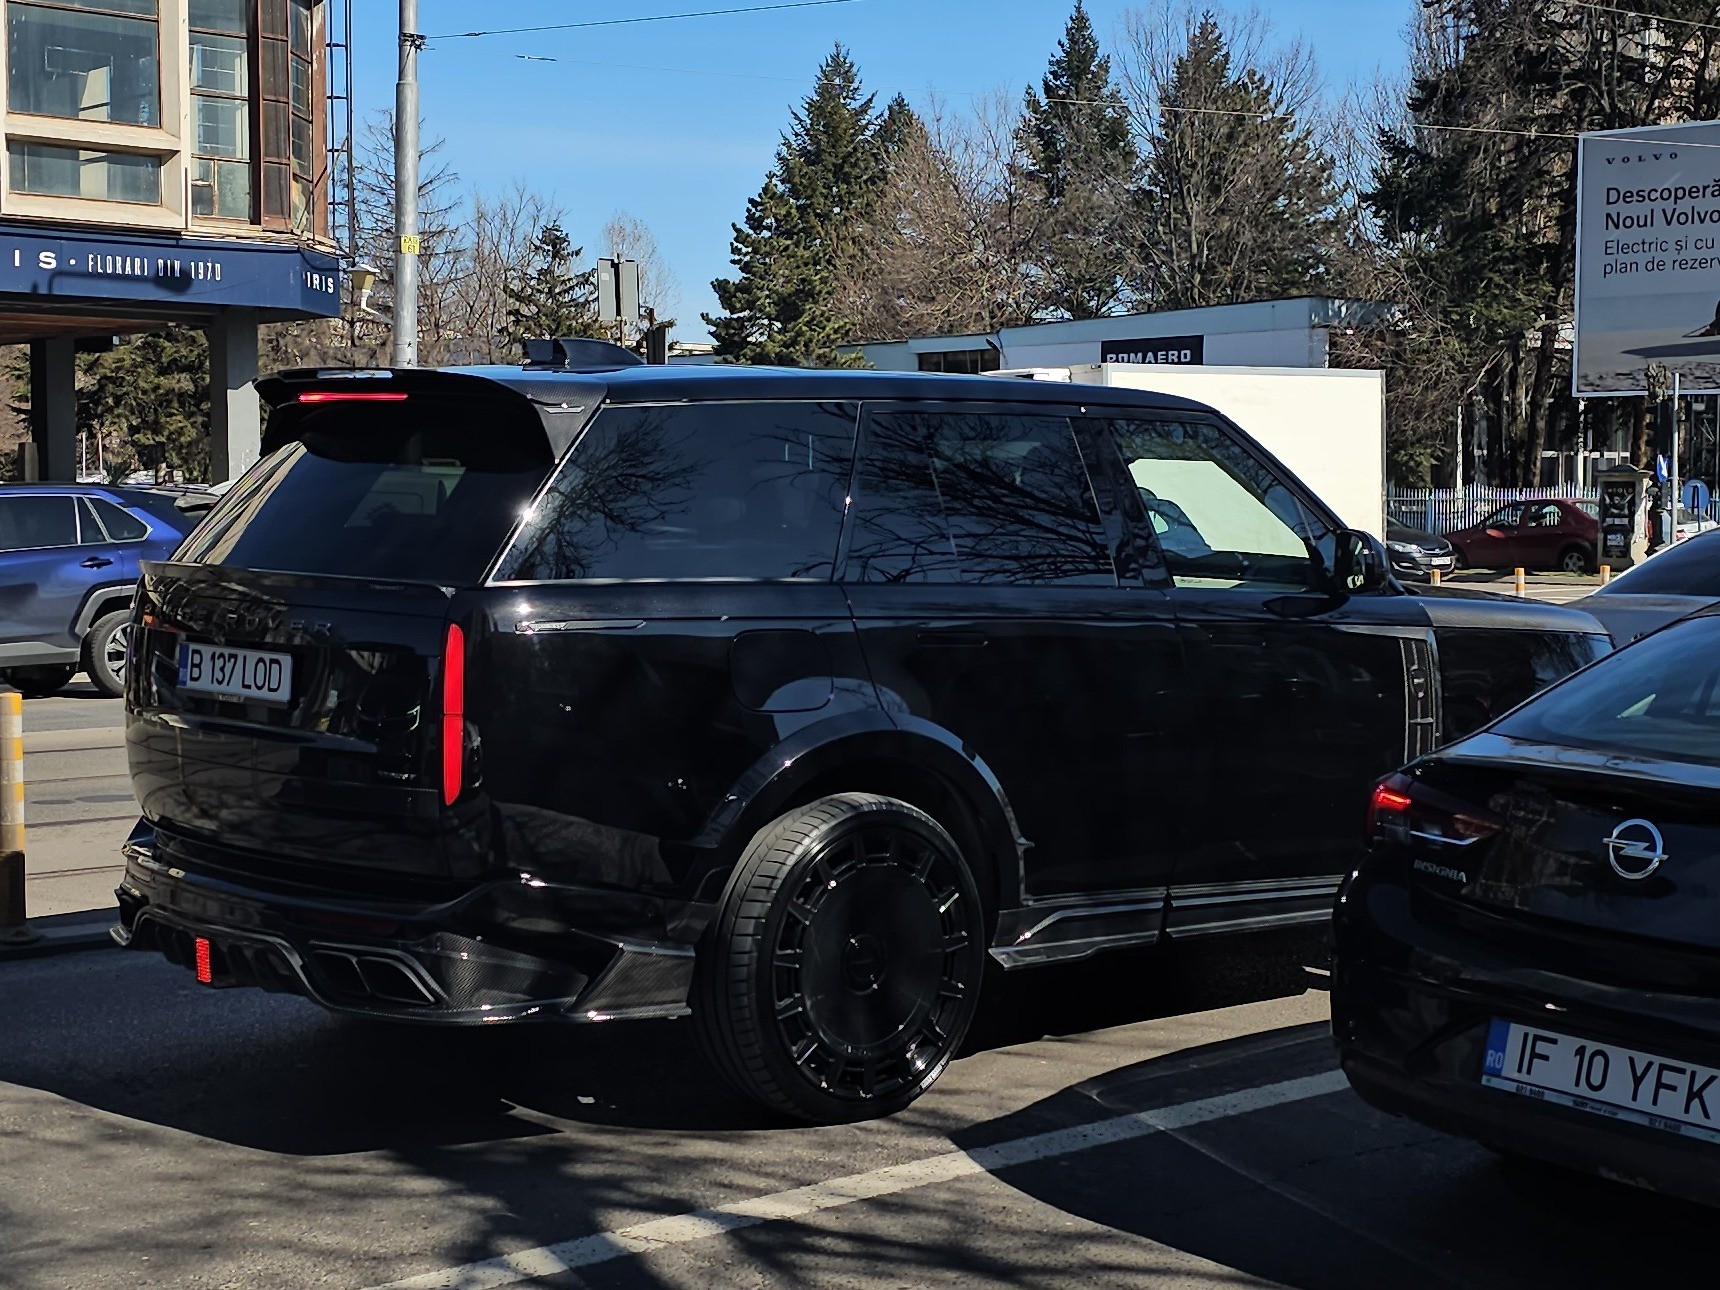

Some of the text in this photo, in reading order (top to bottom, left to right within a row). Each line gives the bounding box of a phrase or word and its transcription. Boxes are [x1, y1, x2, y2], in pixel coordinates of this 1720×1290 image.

[1605, 152, 1678, 165] VOLVO
[1606, 178, 1720, 205] Descoperă
[1605, 206, 1720, 230] Noul Volvo
[1604, 236, 1715, 255] Electric și cu
[88, 253, 148, 276] FLORARI
[190, 258, 221, 281] 1970
[1604, 258, 1639, 278] plan
[1645, 256, 1666, 272] de
[306, 271, 335, 294] IRIS
[1106, 349, 1191, 364] ROMAERO
[189, 649, 282, 693] B 137 LOD
[1485, 1049, 1504, 1070] RO
[1516, 1031, 1719, 1120] IF 10 YFK
